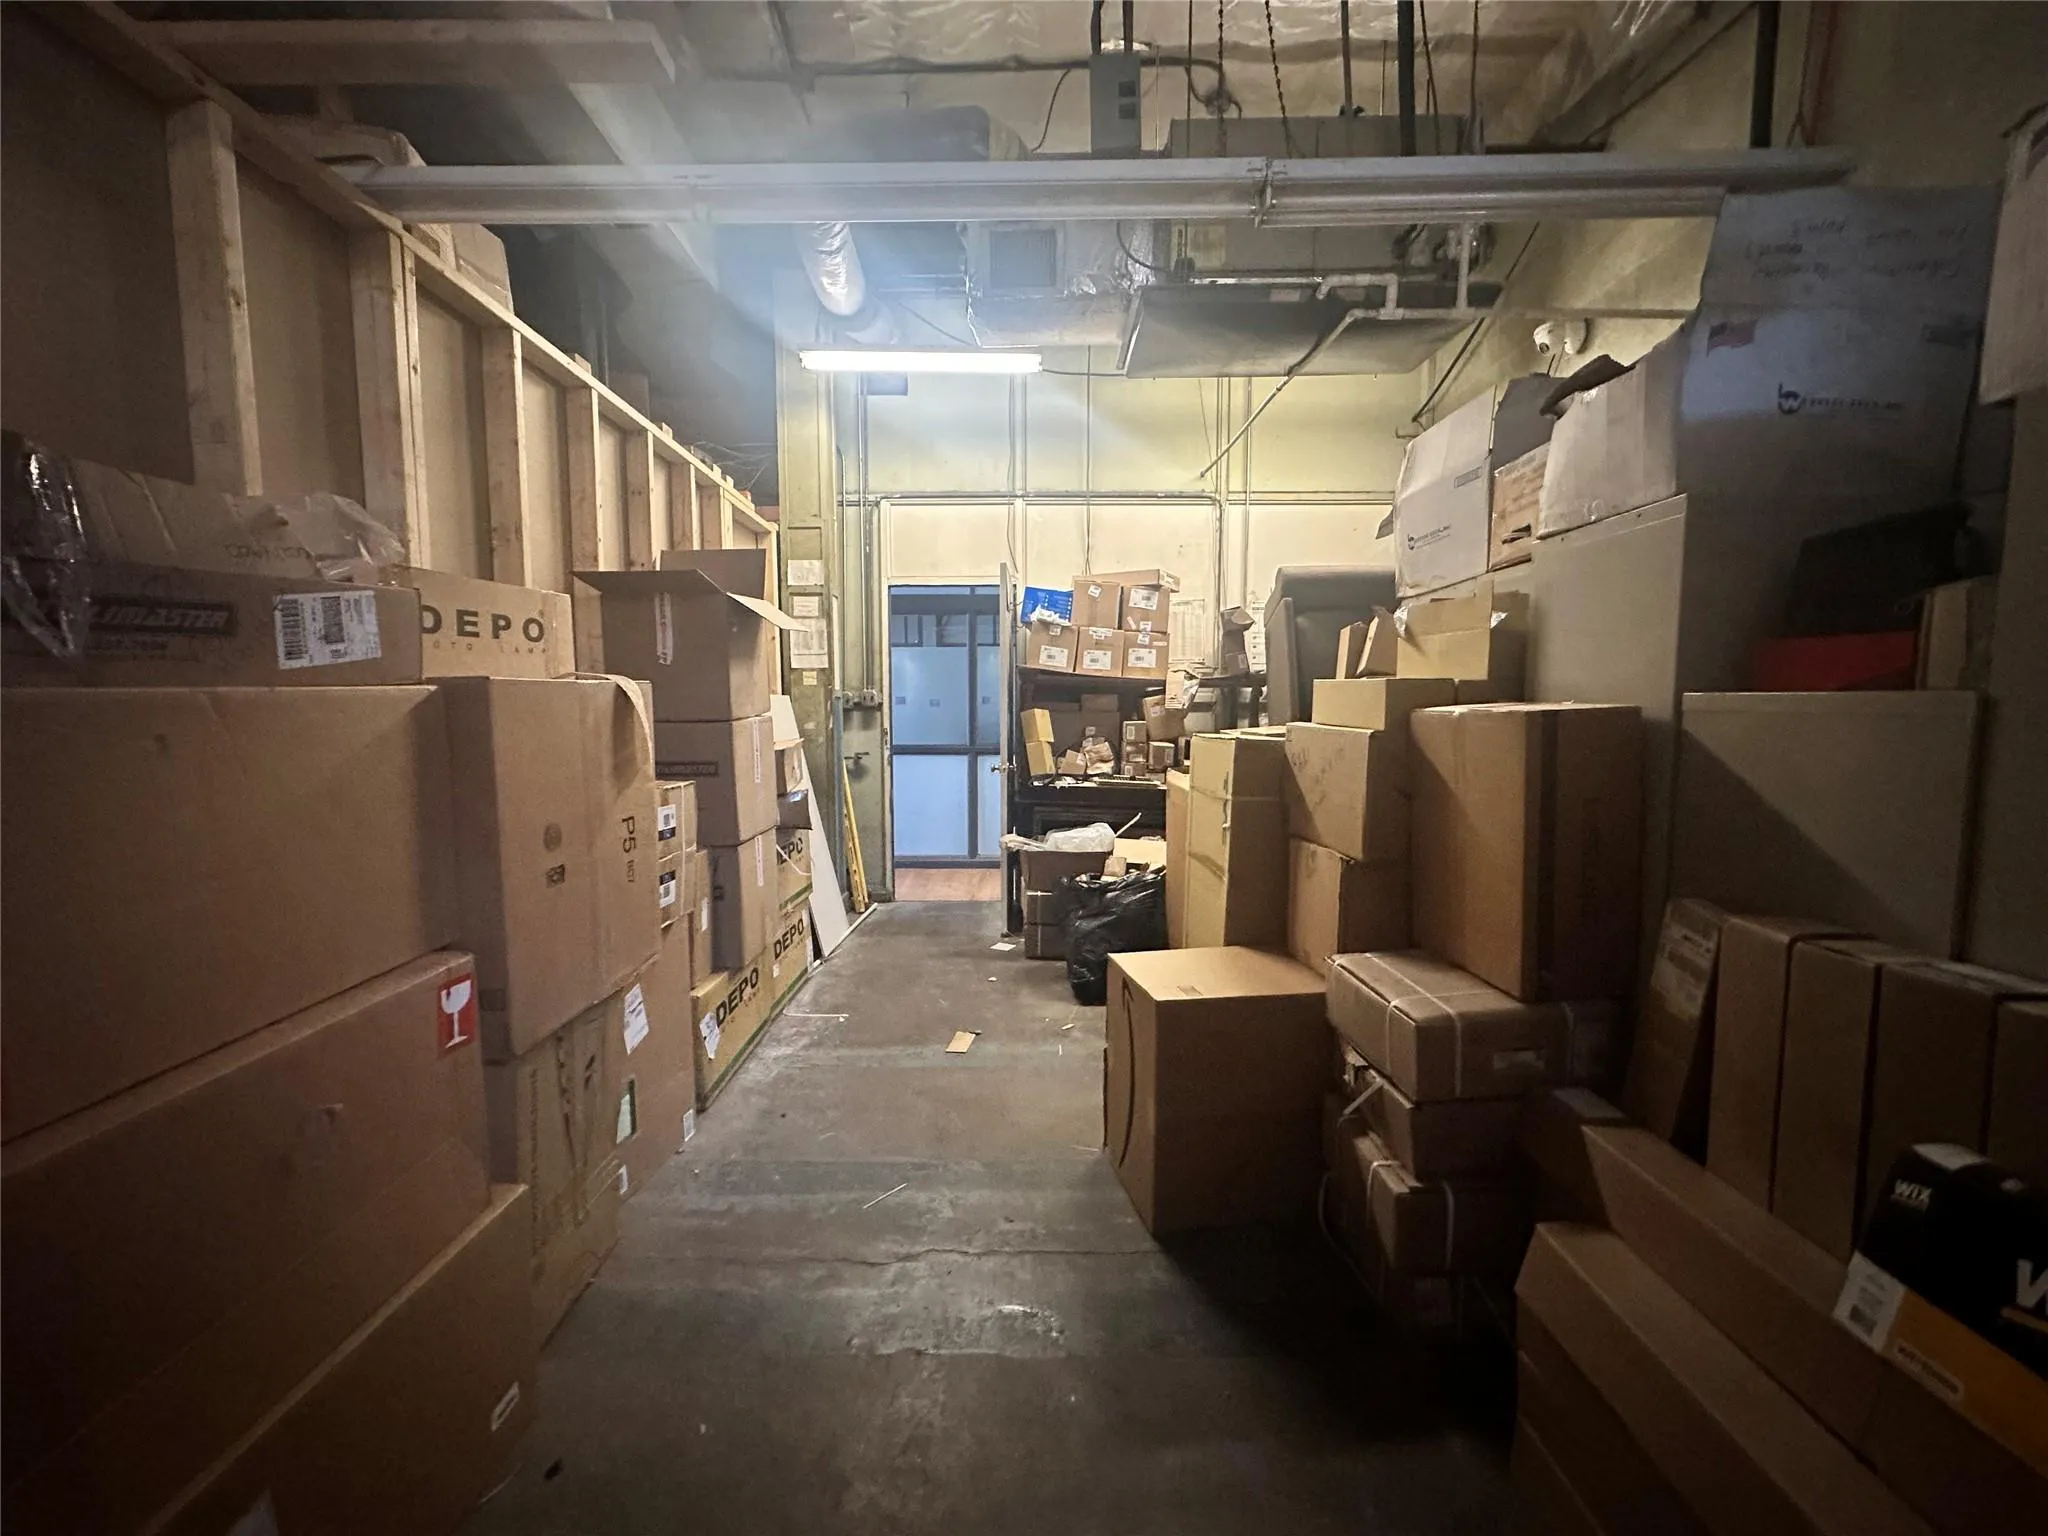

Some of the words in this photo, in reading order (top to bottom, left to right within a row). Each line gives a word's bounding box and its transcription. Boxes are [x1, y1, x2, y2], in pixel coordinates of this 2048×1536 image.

[421, 604, 545, 643] DEPO
[773, 918, 805, 960] DEPO
[715, 967, 759, 1028] DEPO
[1893, 1179, 1933, 1204] WIX
